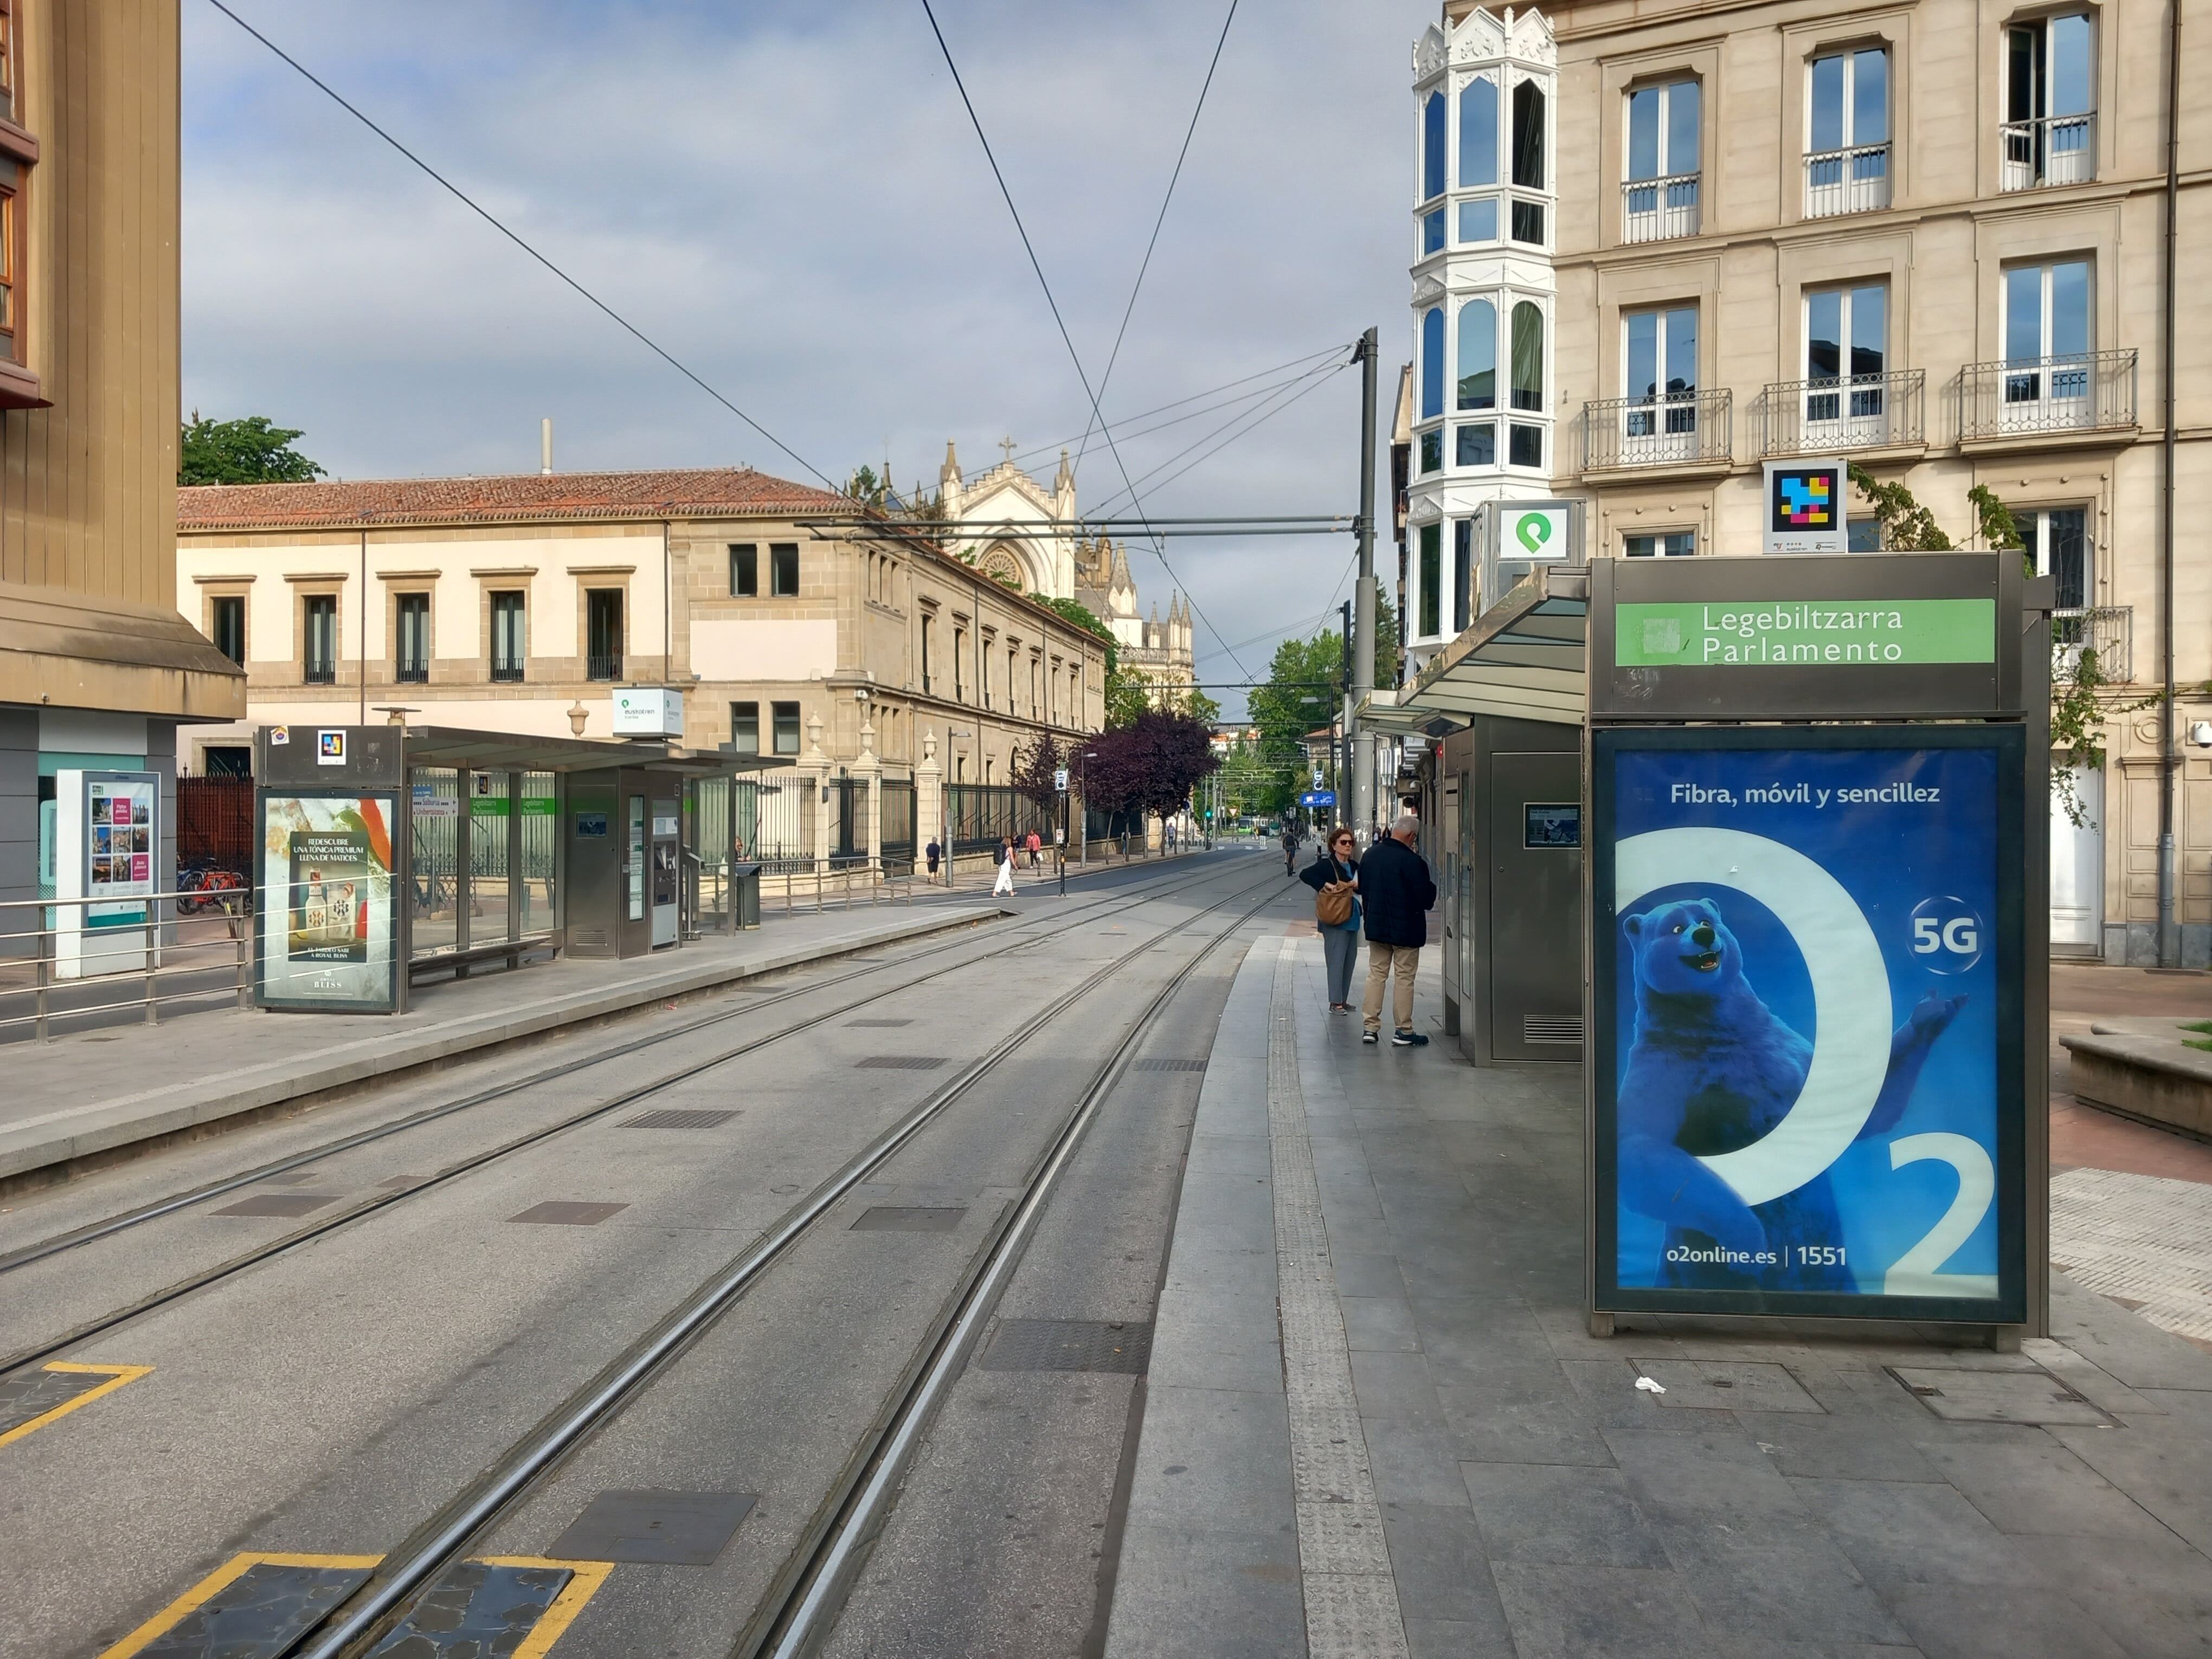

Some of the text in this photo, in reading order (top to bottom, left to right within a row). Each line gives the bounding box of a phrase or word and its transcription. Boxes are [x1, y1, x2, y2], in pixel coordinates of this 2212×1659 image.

[1703, 605, 1903, 638] Legebiltzarra
[1703, 637, 1902, 662] Parlamento
[1671, 782, 1940, 808] Fibra, móvil y sencillez
[1914, 918, 1978, 954] 5G
[1666, 1246, 1846, 1266] o2online.es 1551
